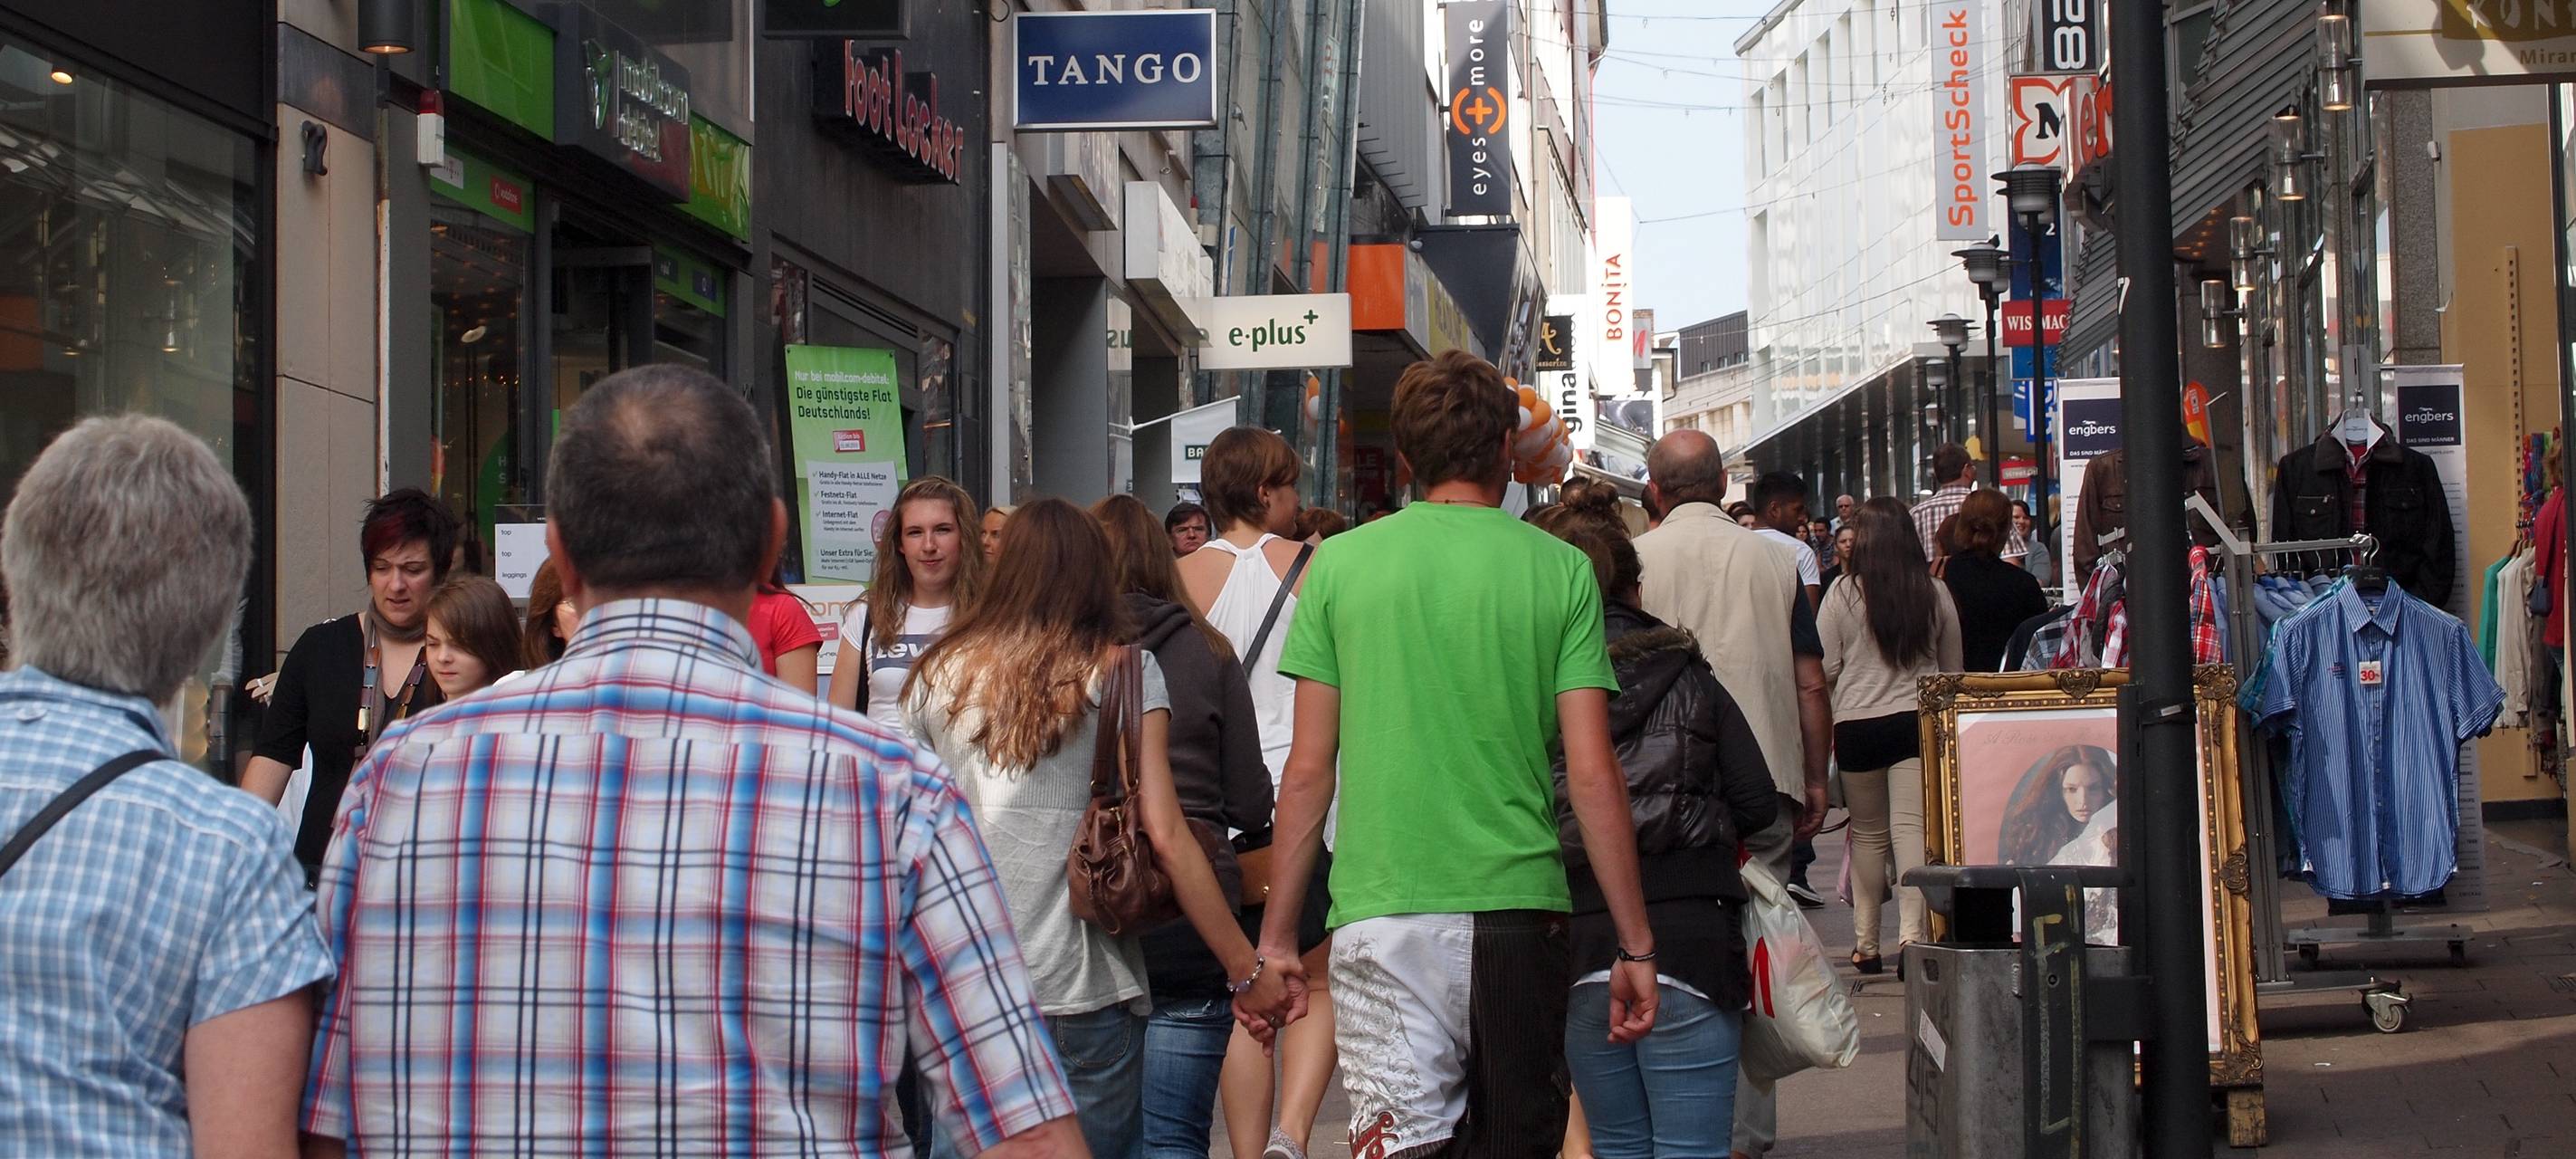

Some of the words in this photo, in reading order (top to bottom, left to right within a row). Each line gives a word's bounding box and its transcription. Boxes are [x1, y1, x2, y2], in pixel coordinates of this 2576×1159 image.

[1469, 19, 1484, 86] more
[1028, 53, 1201, 85] TANGO
[894, 48, 964, 186] Locker
[1942, 9, 1978, 226] SportScheck
[1472, 137, 1492, 196] eyes
[2007, 312, 2070, 330] WISMAC
[797, 386, 813, 399] Die
[816, 387, 870, 405] günstigste
[872, 389, 892, 403] Flat
[797, 405, 871, 420] Deutschlands!
[2405, 411, 2454, 424] engbers
[2069, 424, 2116, 436] engbers
[1187, 447, 1205, 458] BA
[820, 490, 857, 499] Festnetz-Flat
[822, 510, 859, 519] Internet-Flat
[876, 643, 929, 659] Lev
